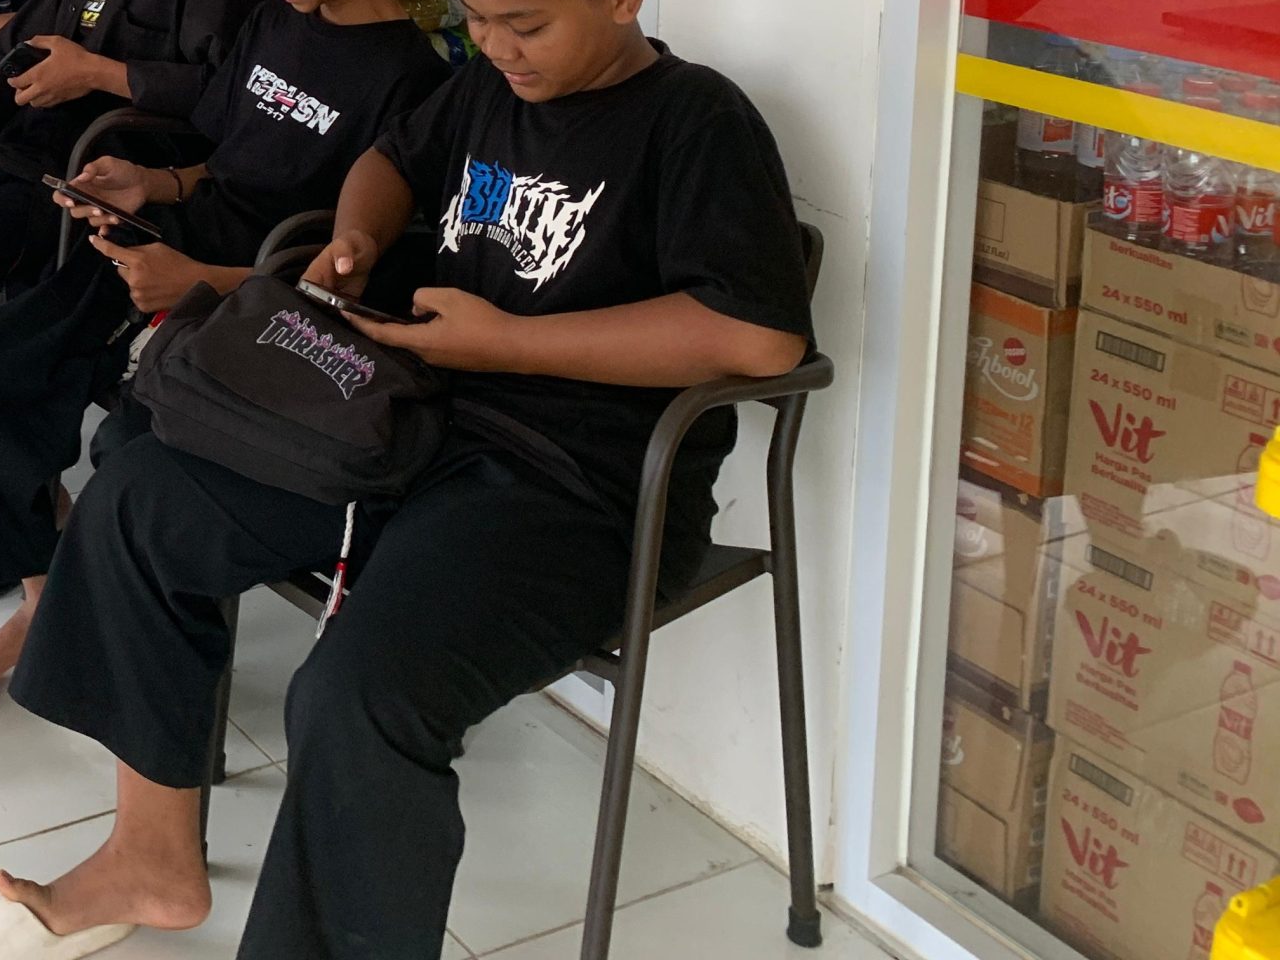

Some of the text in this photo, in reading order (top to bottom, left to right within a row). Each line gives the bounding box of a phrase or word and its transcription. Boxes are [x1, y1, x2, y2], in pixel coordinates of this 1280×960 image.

[1102, 285, 1188, 325] 24 x 550 ml
[256, 309, 376, 401] THRASHER
[1089, 368, 1177, 411] 24 x 550 ml
[1087, 399, 1167, 465] Vit
[1094, 451, 1153, 483] Harga Pas
[1077, 580, 1096, 599] 24
[1109, 595, 1140, 619] 550
[1142, 613, 1164, 630] ml
[1074, 609, 1153, 678] Vit
[1062, 788, 1080, 807] 24
[1091, 806, 1119, 831] 550
[1120, 827, 1141, 846] ml
[1060, 816, 1130, 890] Vit
